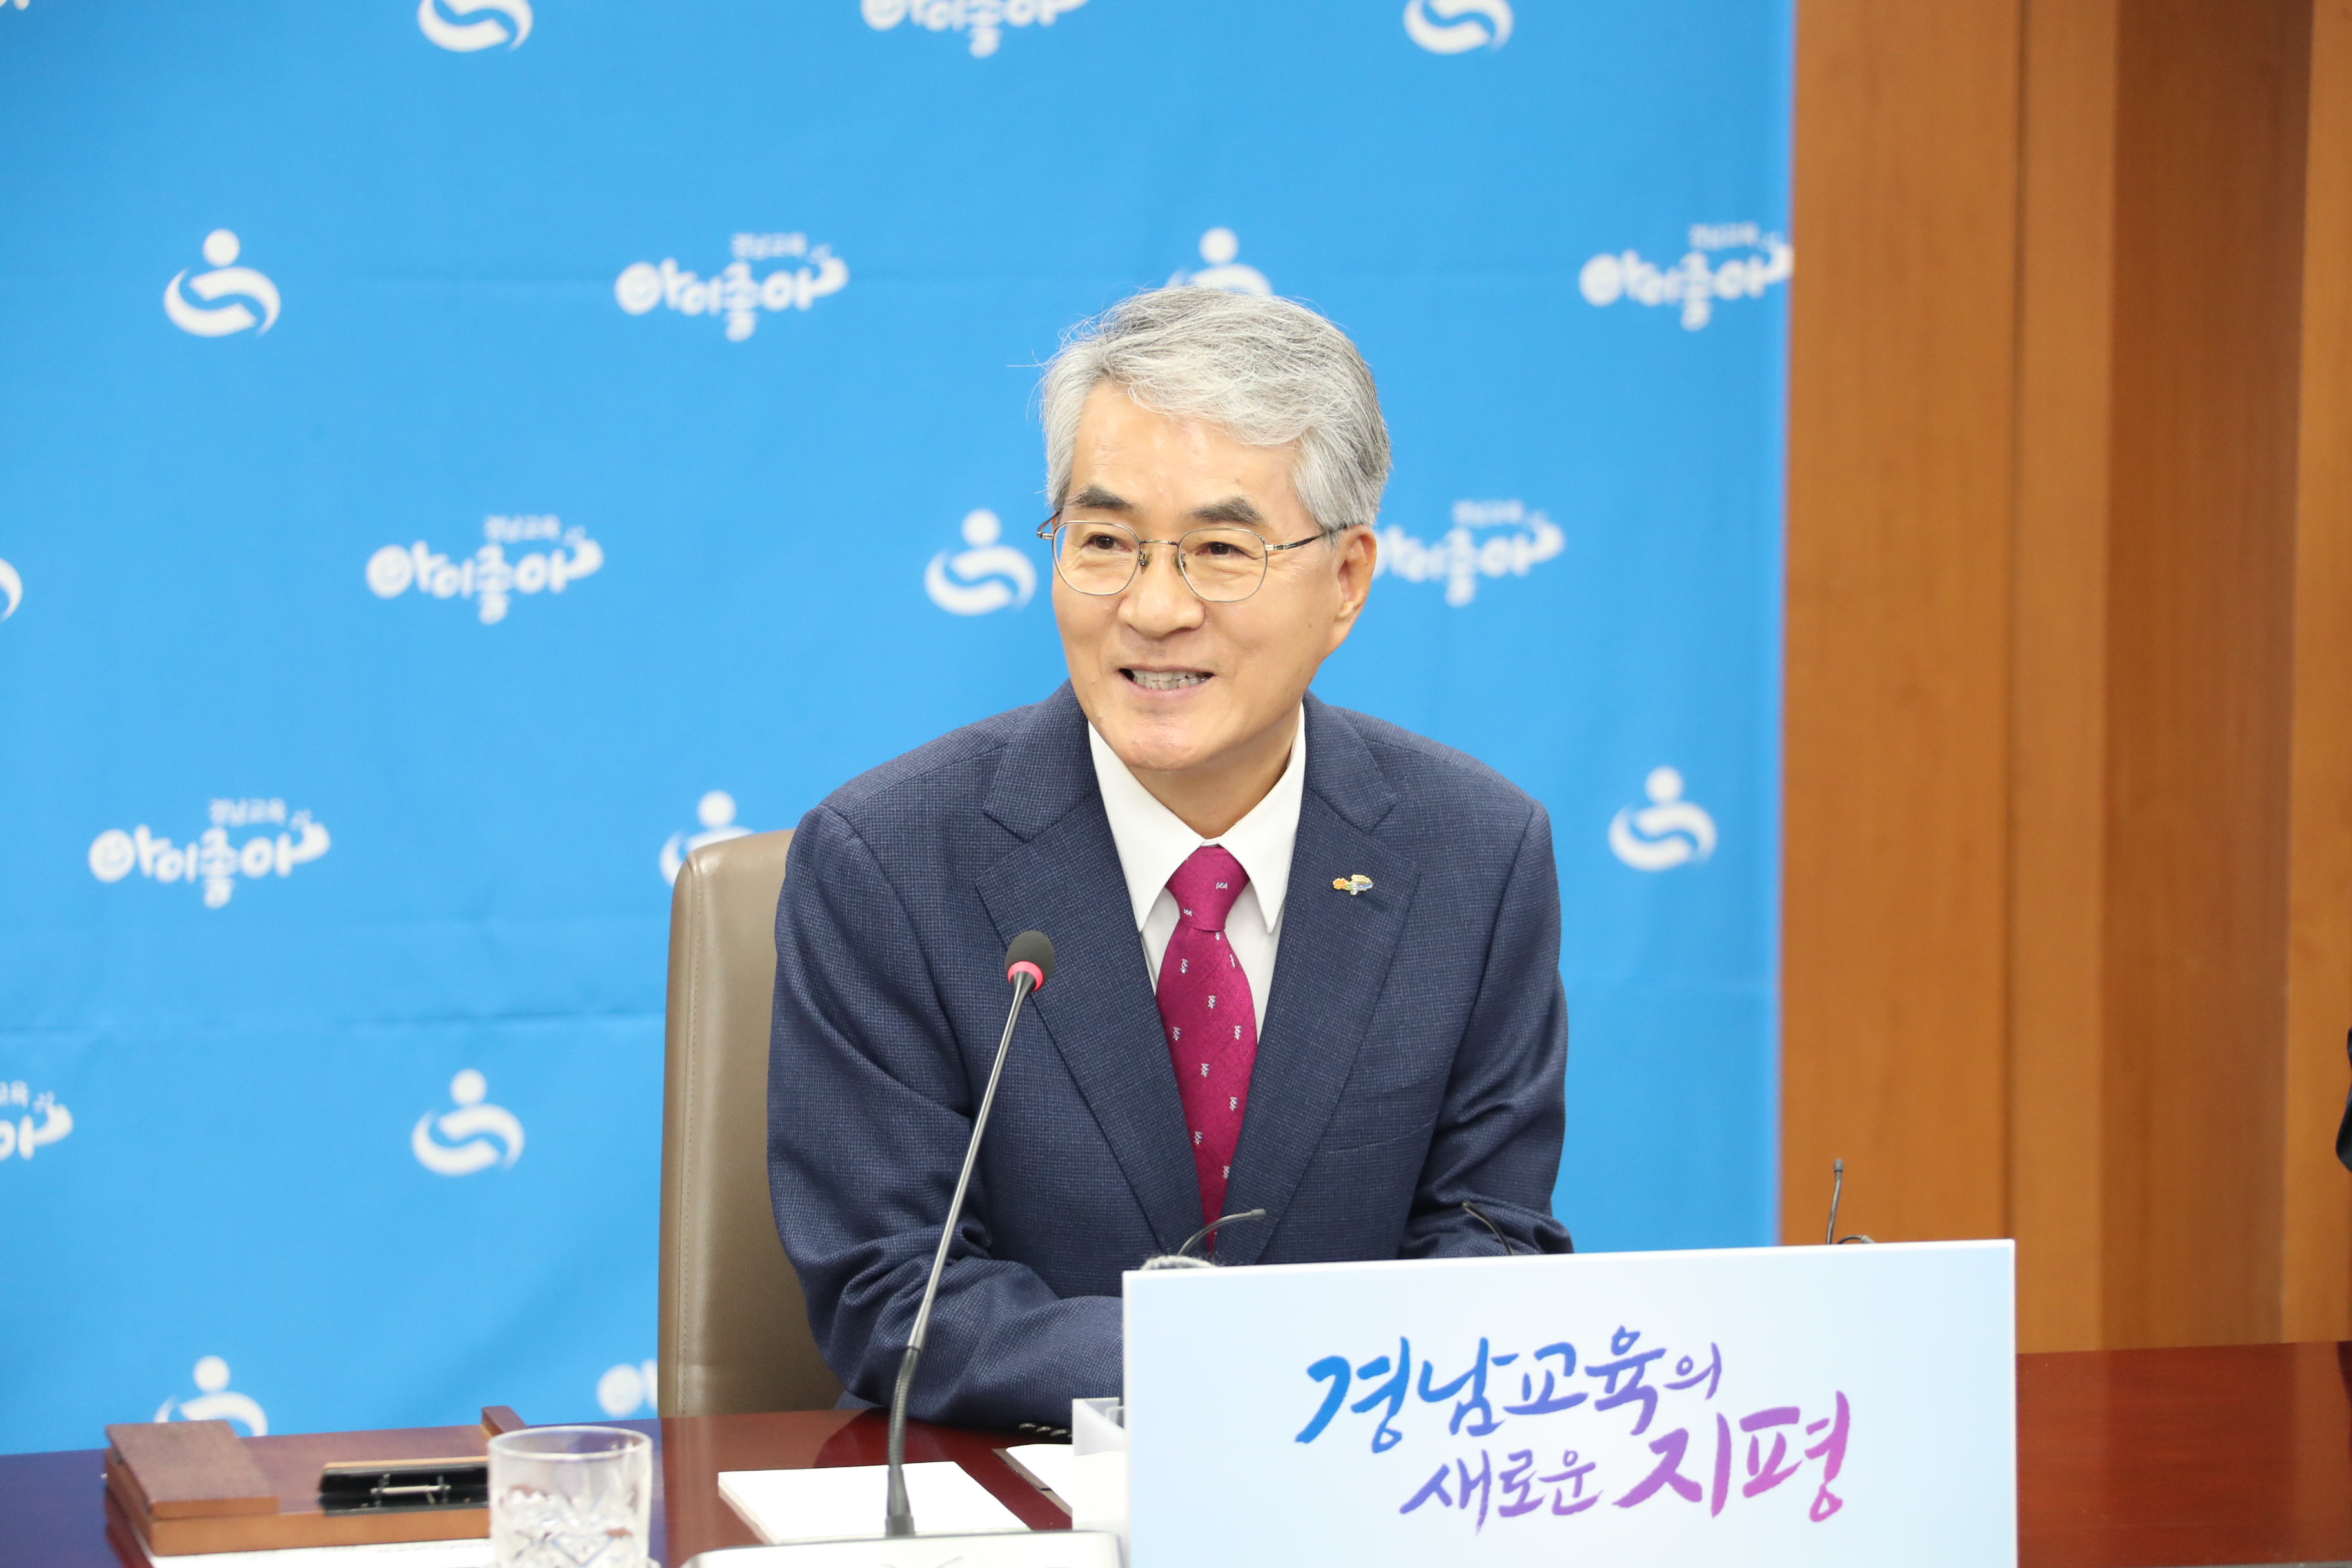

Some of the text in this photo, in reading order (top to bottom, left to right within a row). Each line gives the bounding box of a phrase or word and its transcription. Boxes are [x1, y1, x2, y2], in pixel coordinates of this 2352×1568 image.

[614, 258, 848, 342] 아이좋아
[366, 539, 603, 624] 아이좋아
[88, 822, 331, 908] 아이좋아
[1295, 1326, 1721, 1453] 경남교육의
[1399, 1391, 1850, 1535] 새로운 지평
